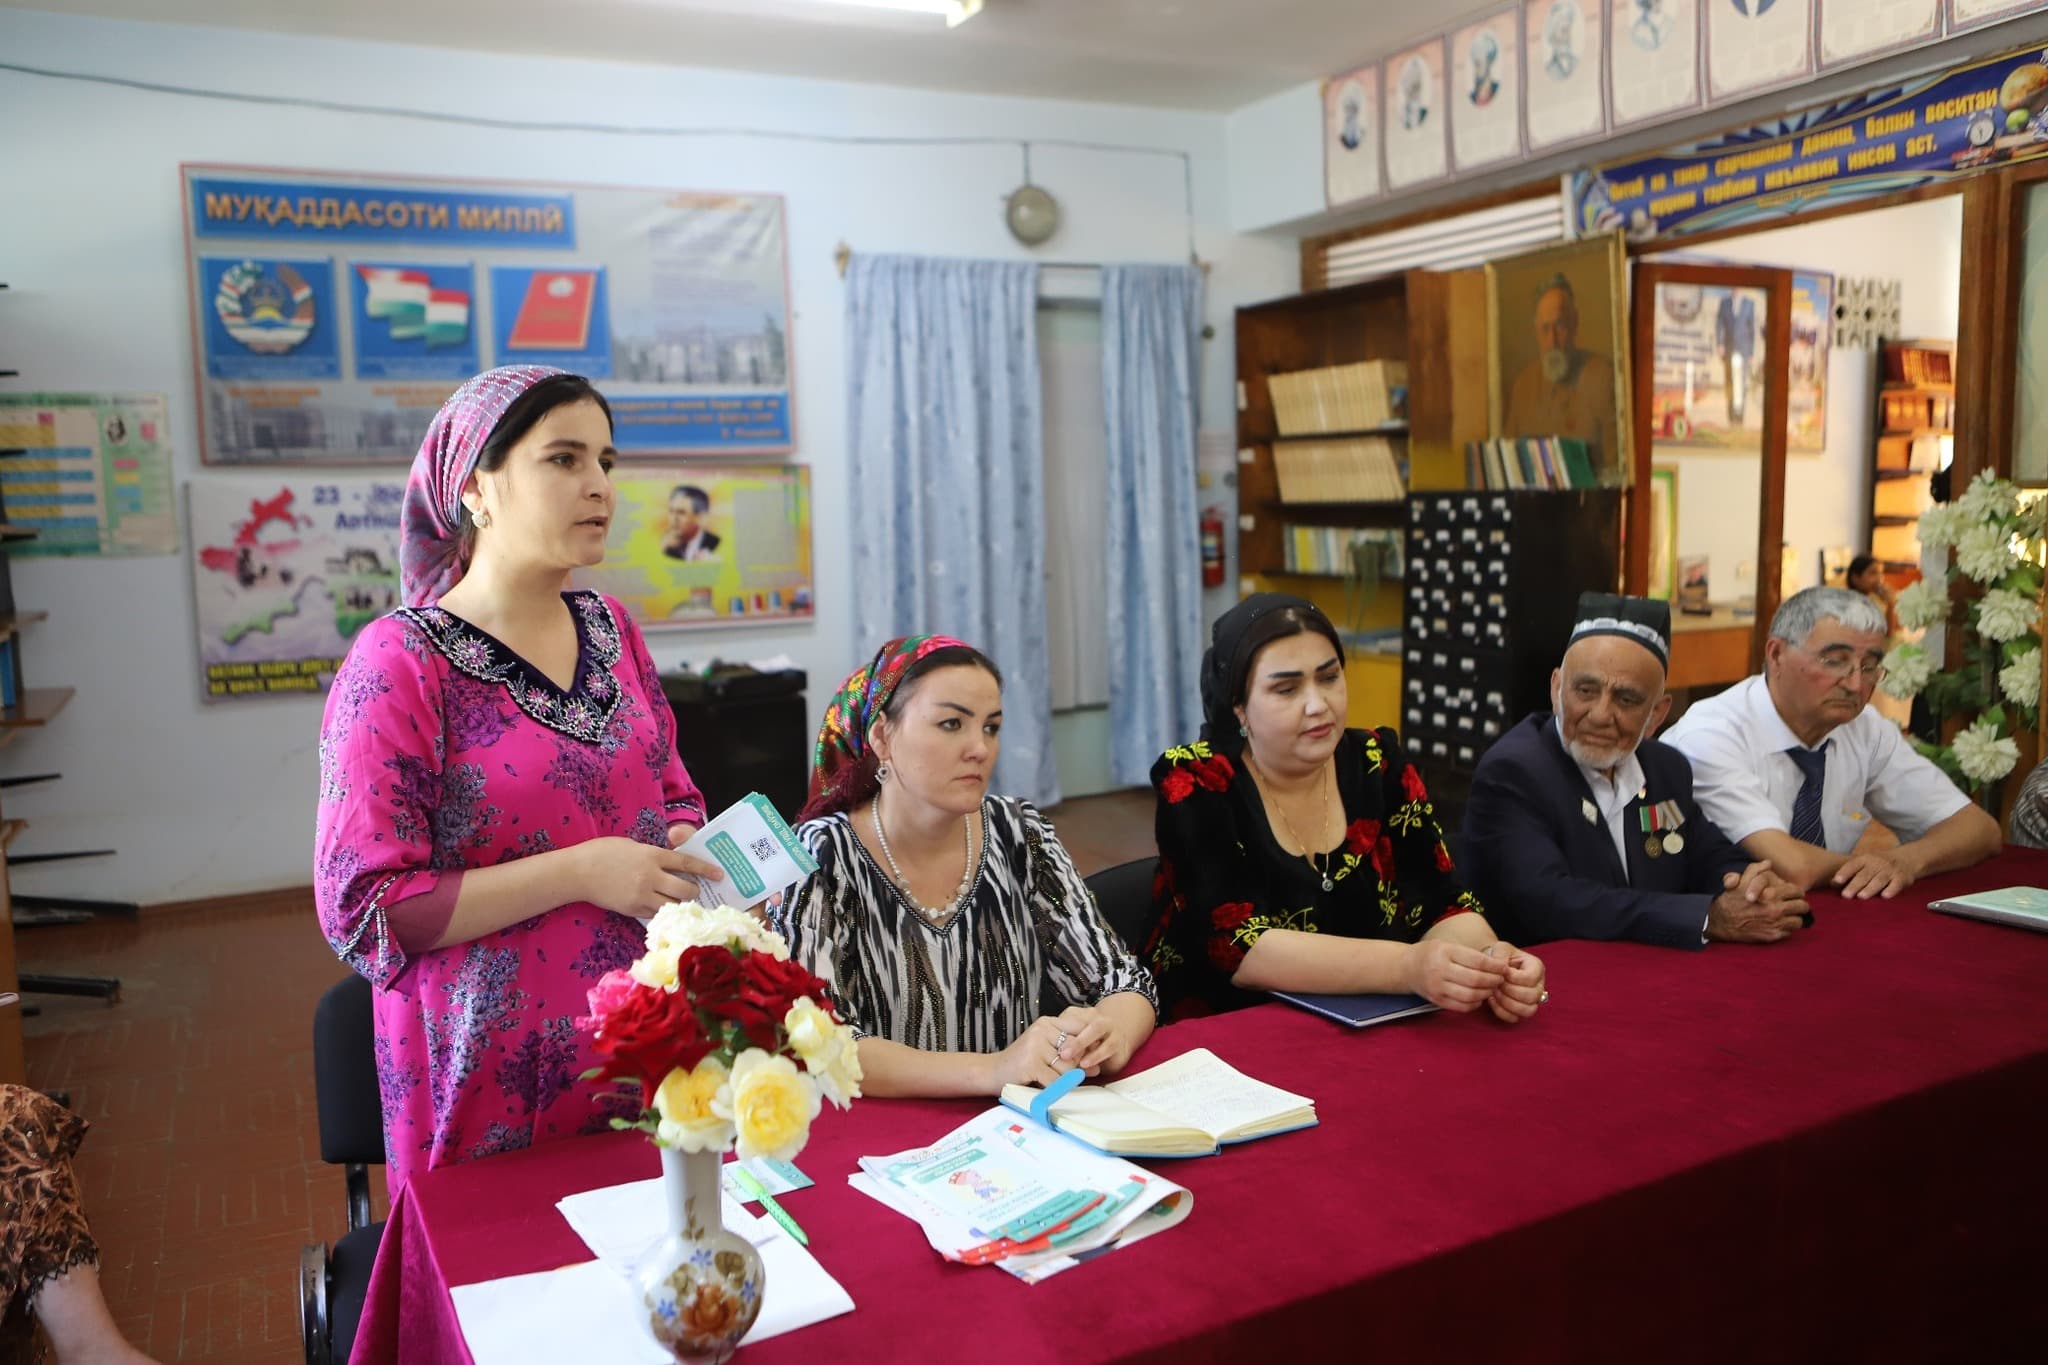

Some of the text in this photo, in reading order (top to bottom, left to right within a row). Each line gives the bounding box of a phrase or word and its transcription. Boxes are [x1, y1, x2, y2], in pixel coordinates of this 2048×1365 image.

[1865, 110, 1916, 139] балки
[1925, 88, 1998, 124] воситаи
[205, 193, 449, 229] МУҚАДДАСОТИ
[313, 486, 340, 505] 23
